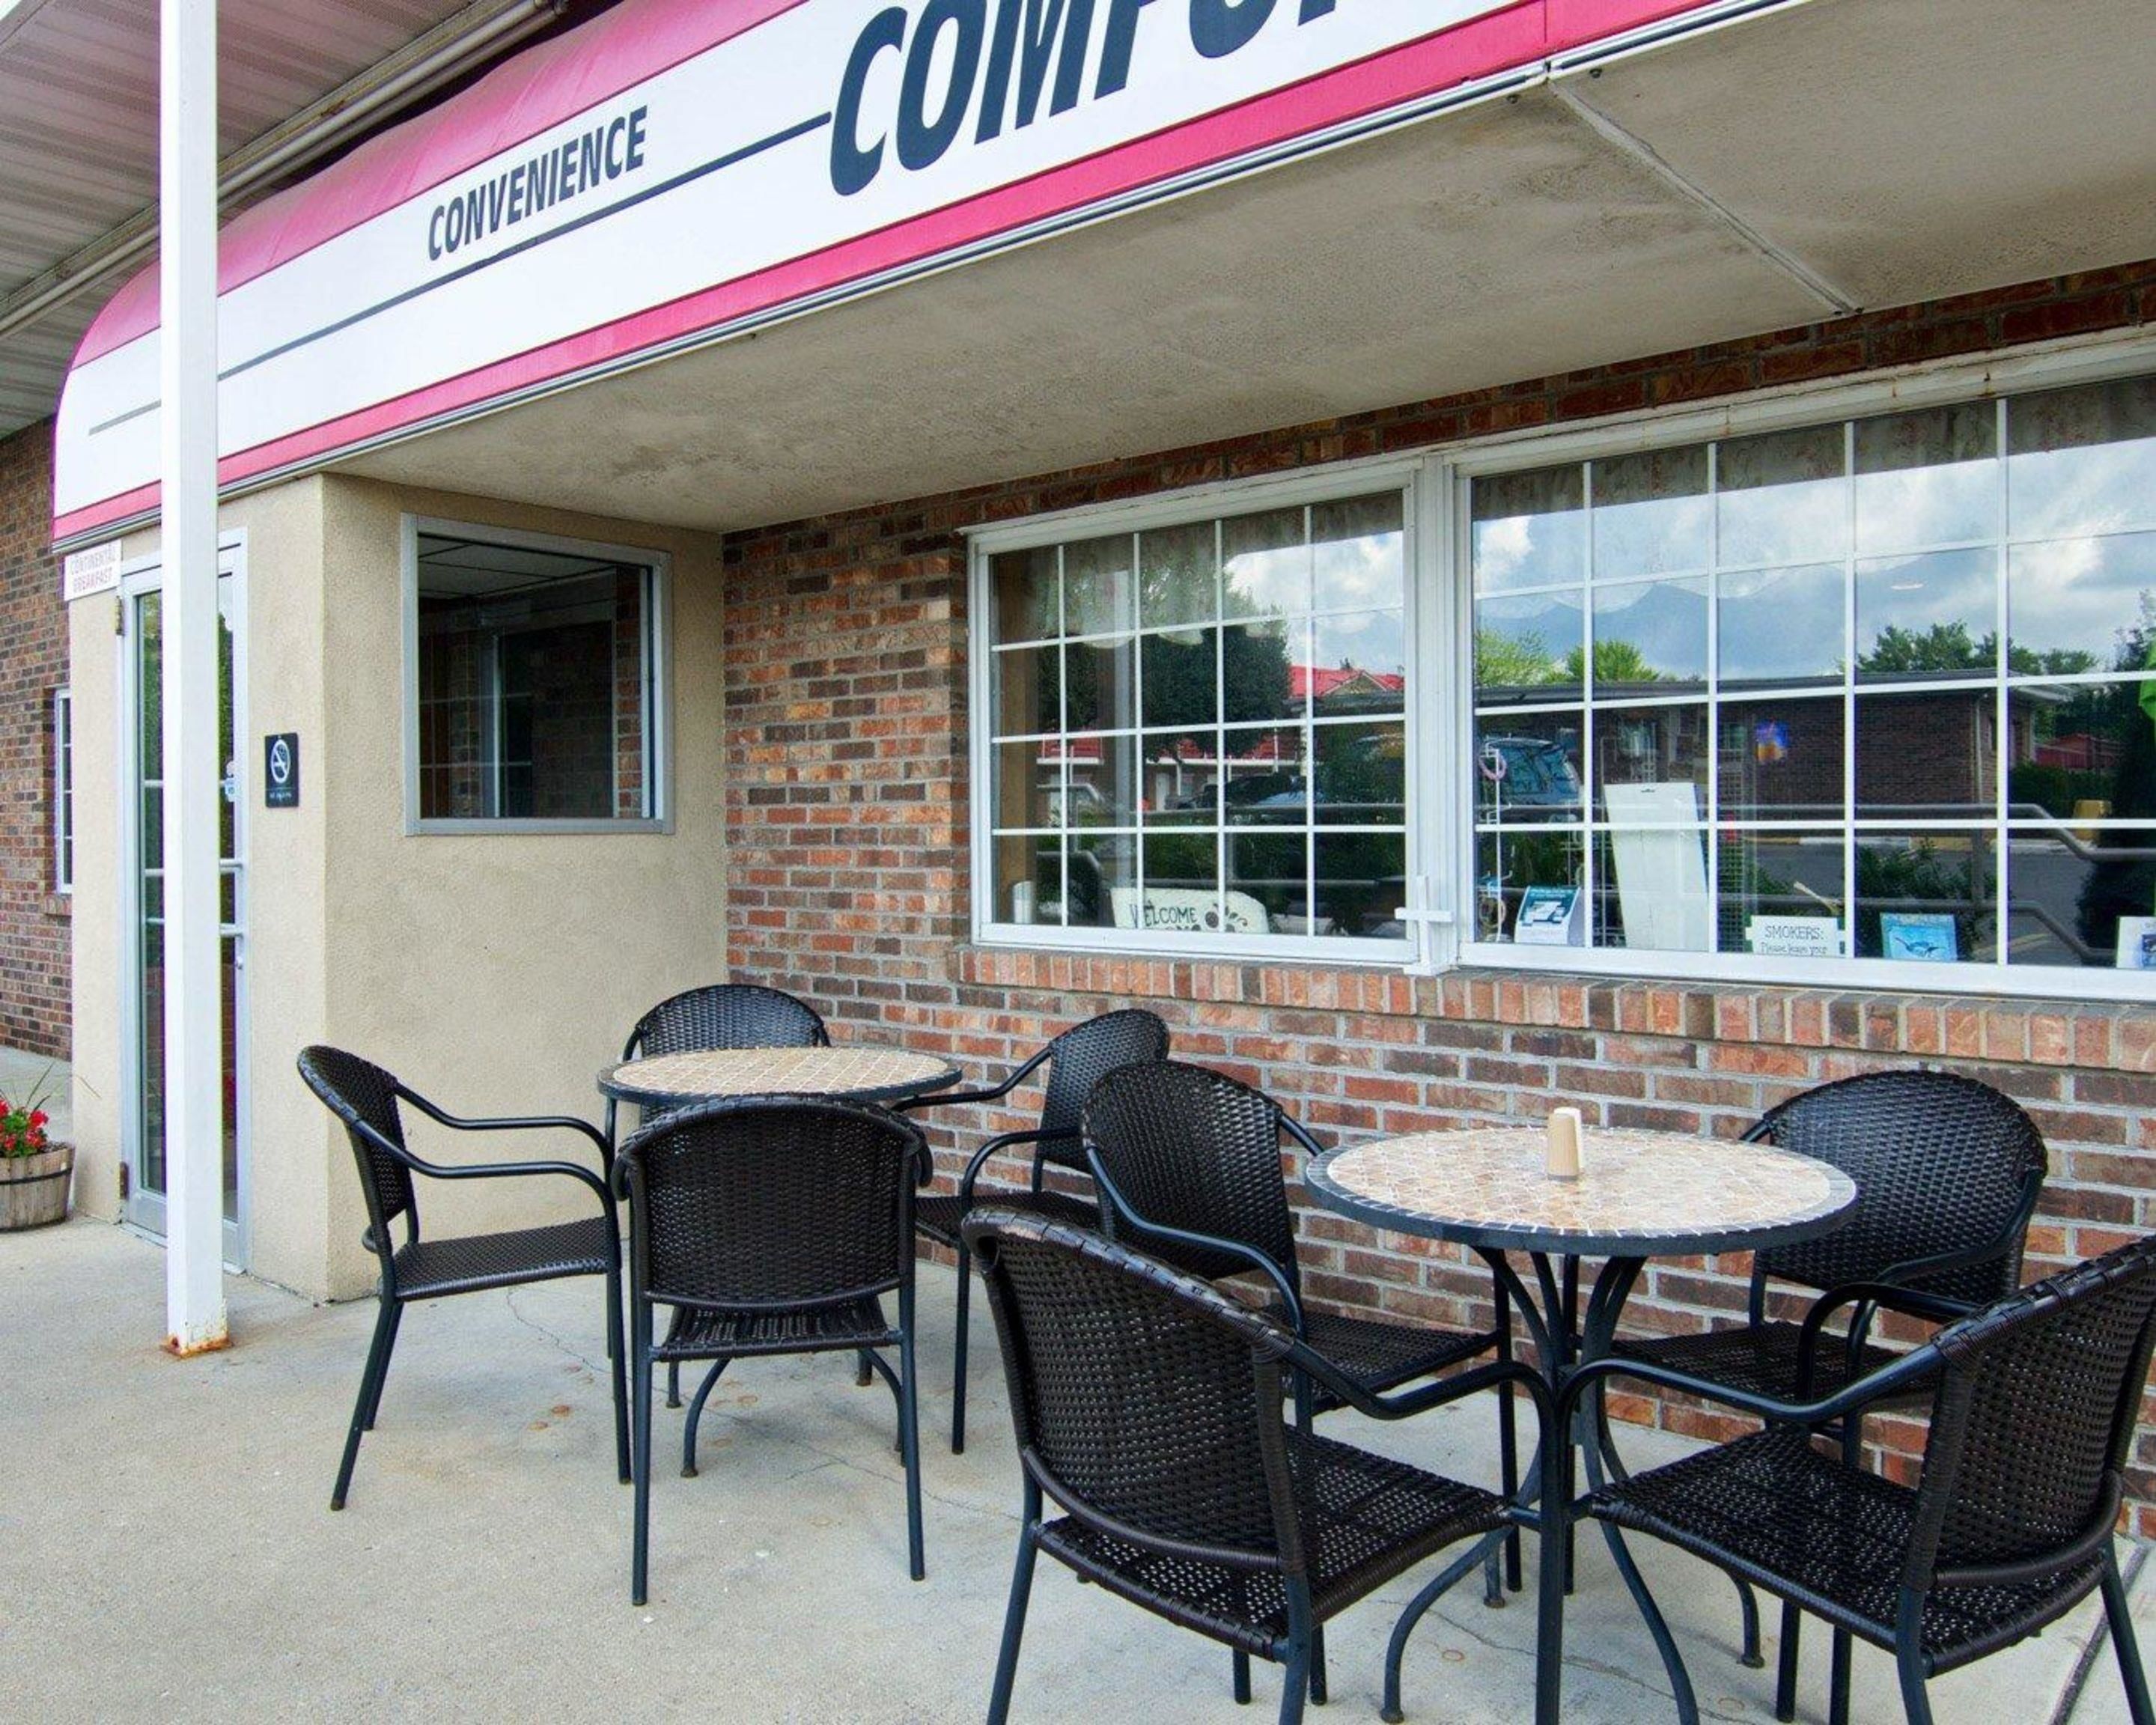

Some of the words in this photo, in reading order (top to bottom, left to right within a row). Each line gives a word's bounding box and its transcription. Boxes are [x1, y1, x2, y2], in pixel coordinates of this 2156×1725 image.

[830, 0, 1336, 197] COM
[427, 105, 648, 261] CONVENIENCE
[70, 544, 117, 575] CONTINENTAL
[73, 567, 113, 593] BREAKFAST
[1764, 925, 1824, 940] SMOKERS:
